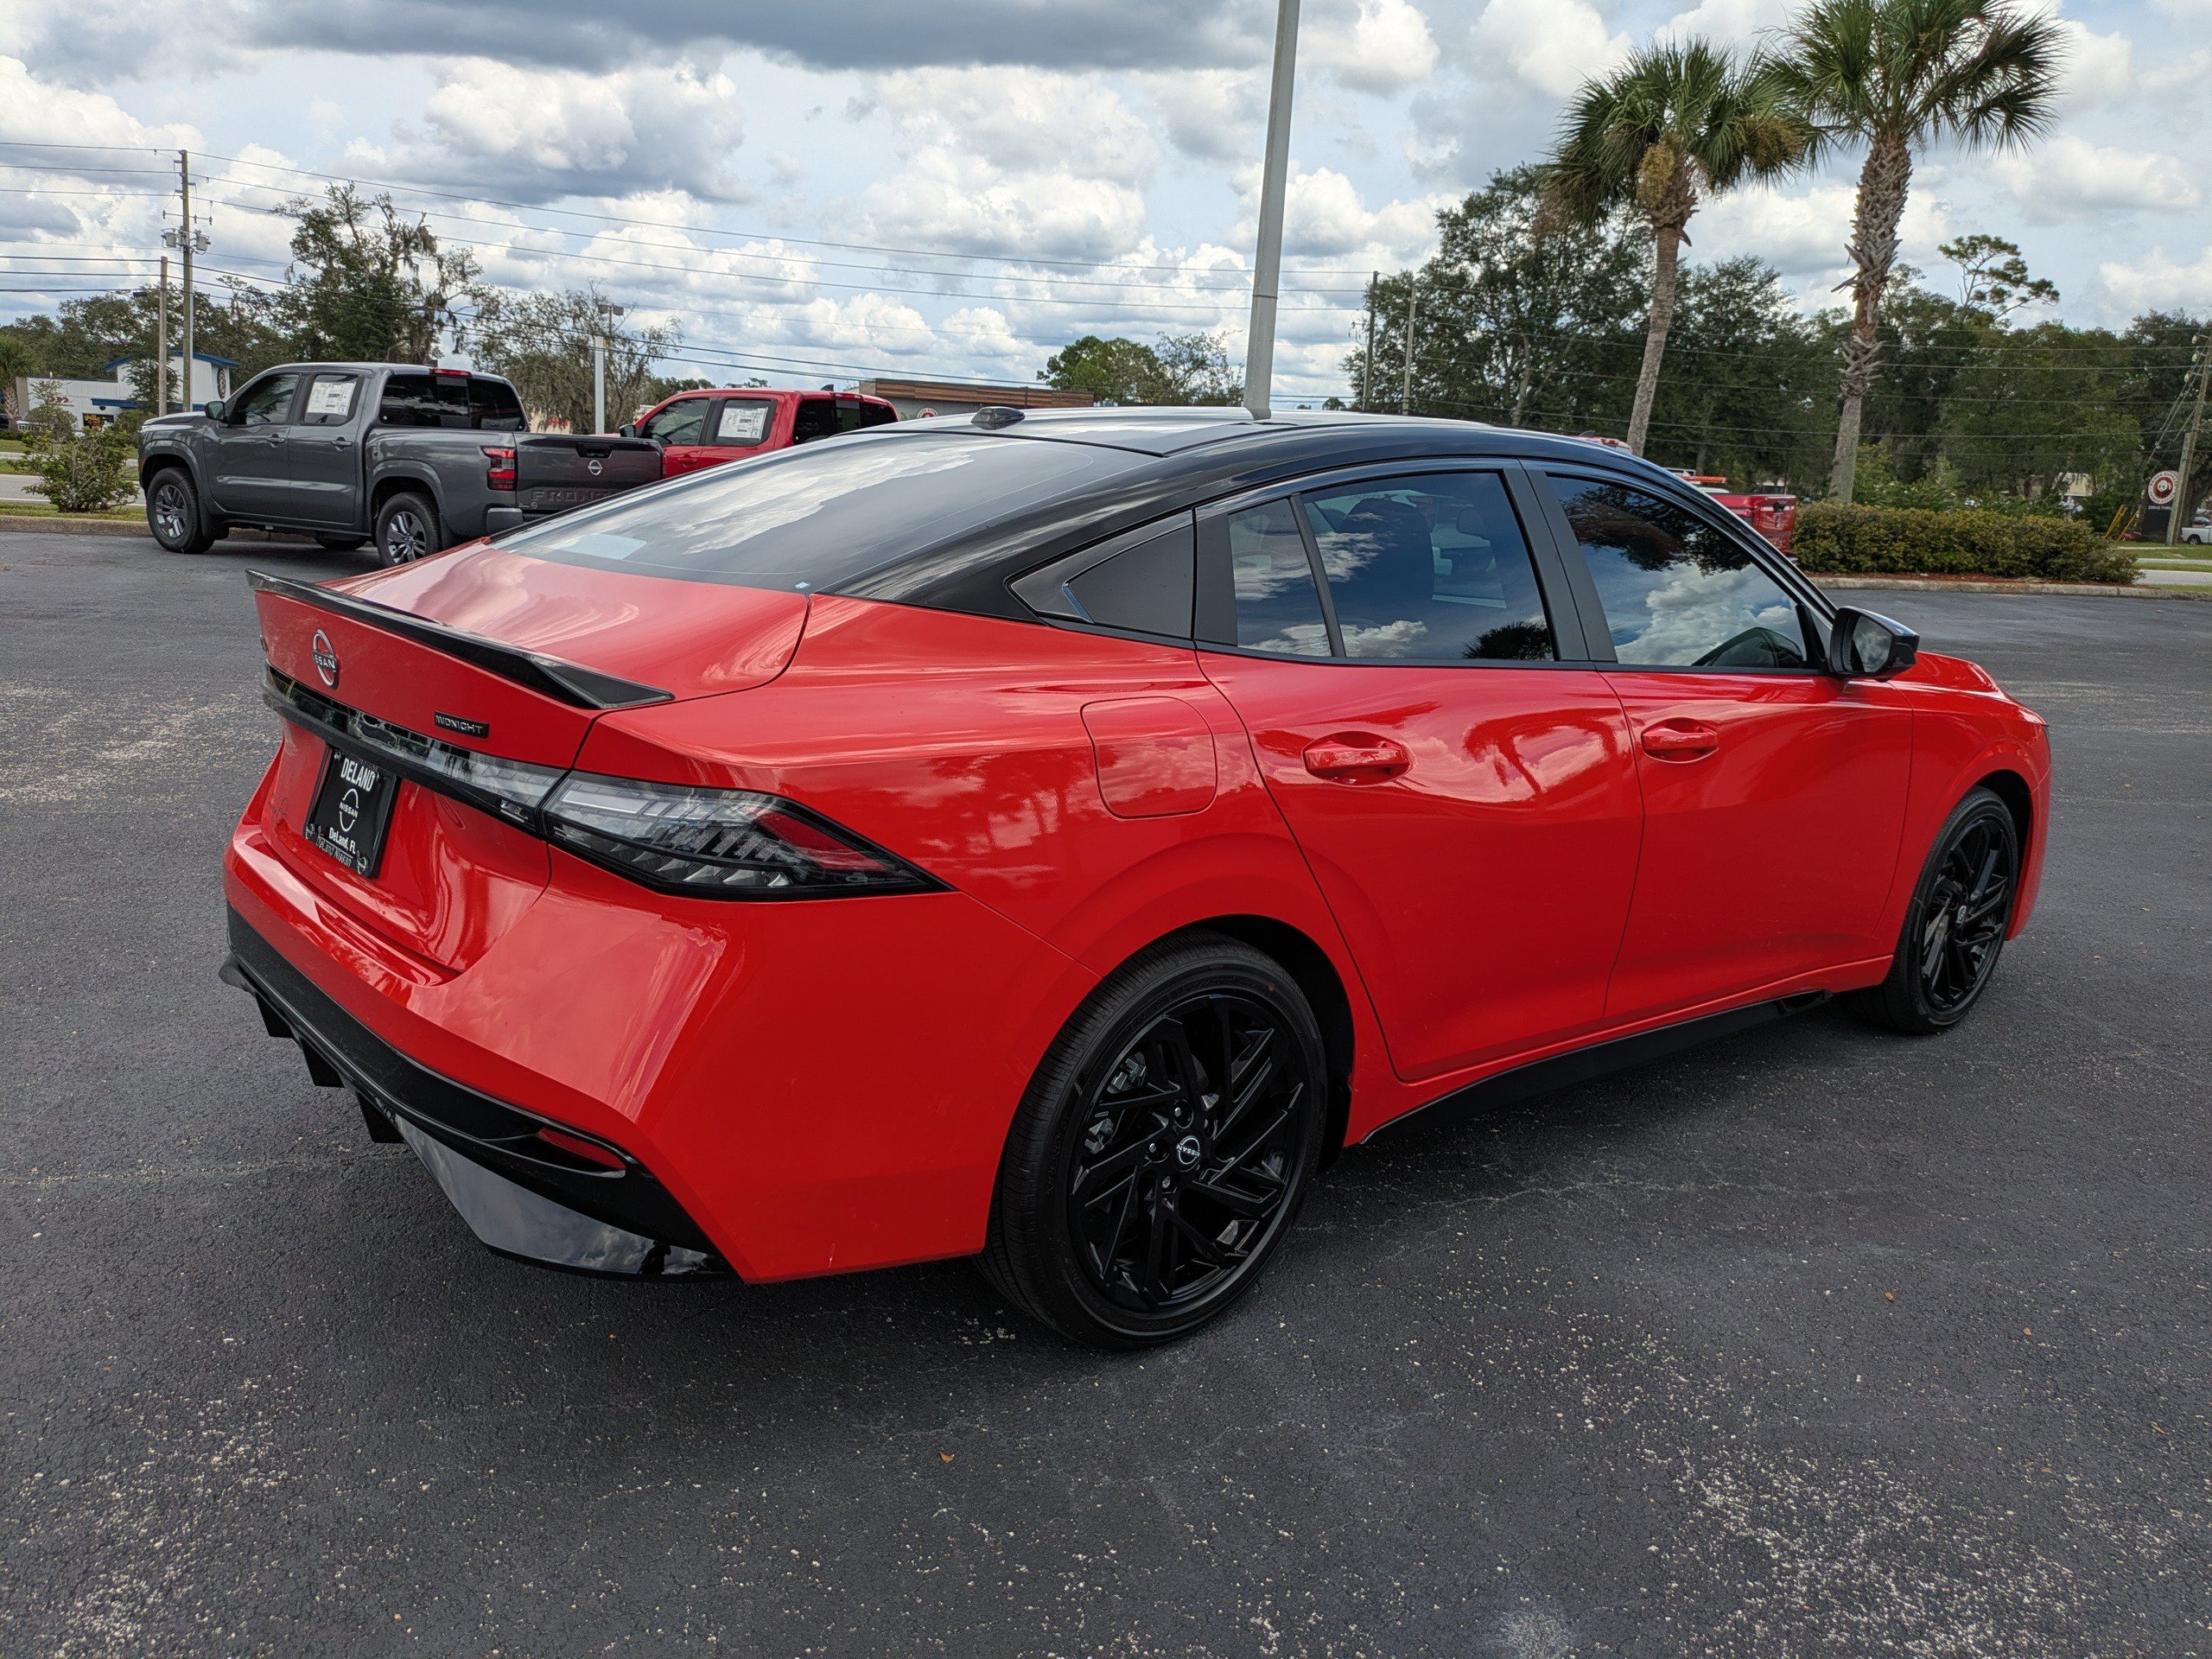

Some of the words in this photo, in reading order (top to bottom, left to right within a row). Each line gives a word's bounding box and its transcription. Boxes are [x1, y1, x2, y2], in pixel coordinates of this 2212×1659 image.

[435, 715, 484, 734] MIDNIGHT
[340, 757, 376, 792] DELAND
[339, 801, 359, 818] NISSAN
[349, 839, 356, 855] FL
[1176, 1143, 1201, 1158] NISSAN
